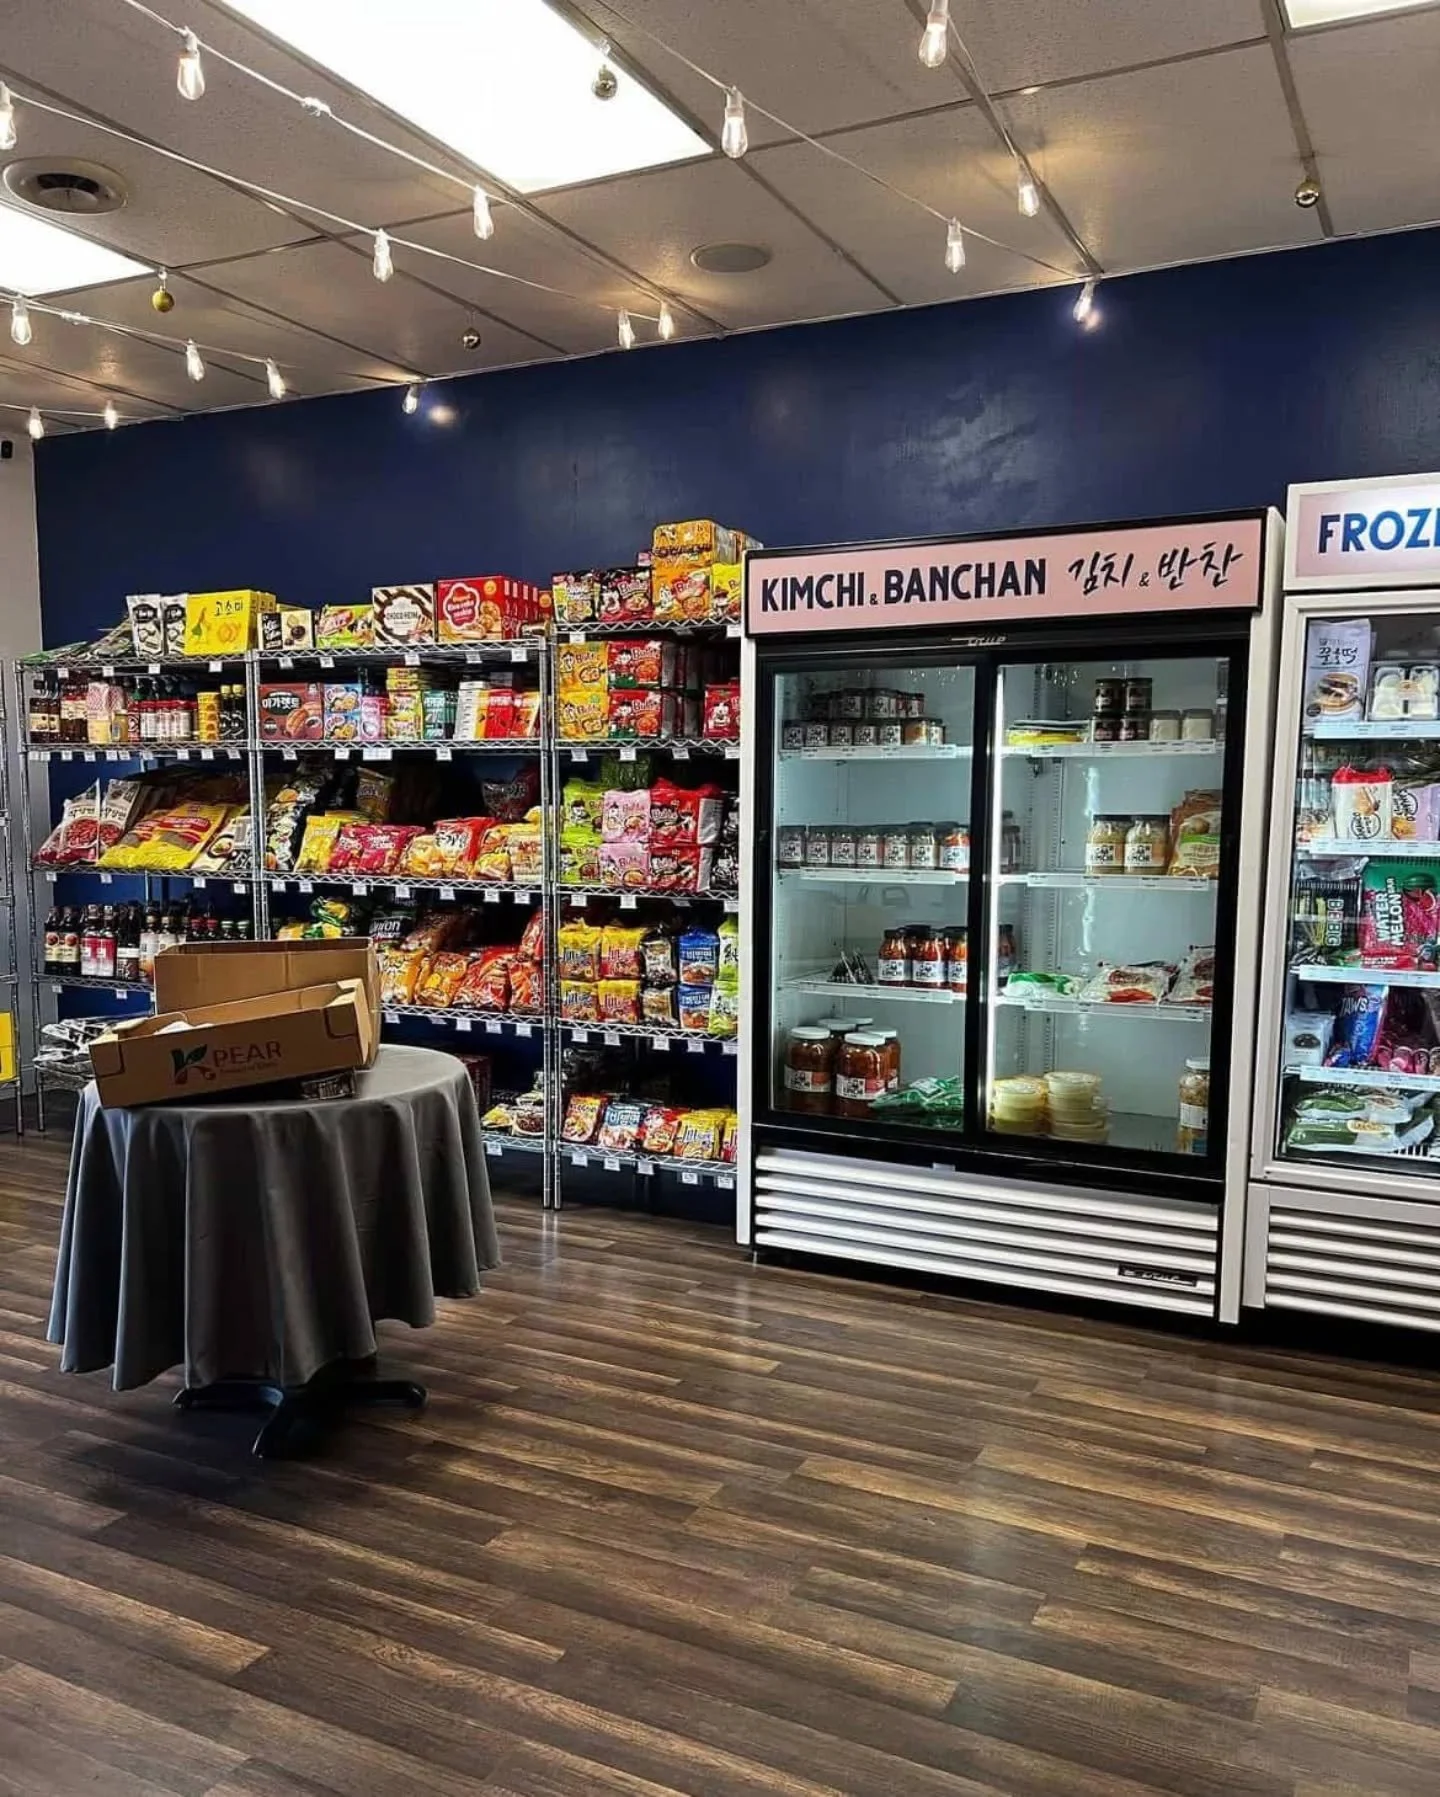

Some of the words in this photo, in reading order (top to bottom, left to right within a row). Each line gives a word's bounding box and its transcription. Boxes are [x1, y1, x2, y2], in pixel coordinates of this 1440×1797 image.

[1318, 507, 1440, 554] FROZ
[761, 573, 865, 613] KIMCHI
[870, 593, 879, 606] &
[884, 558, 1046, 604] BANCHAN
[1068, 551, 1131, 595] 김치
[1138, 572, 1151, 588] &
[1156, 542, 1243, 591] 반찬
[214, 601, 244, 616] 고소미
[1376, 892, 1390, 942] WATER
[1388, 893, 1405, 946] MELON
[213, 1040, 282, 1068] PEAR
